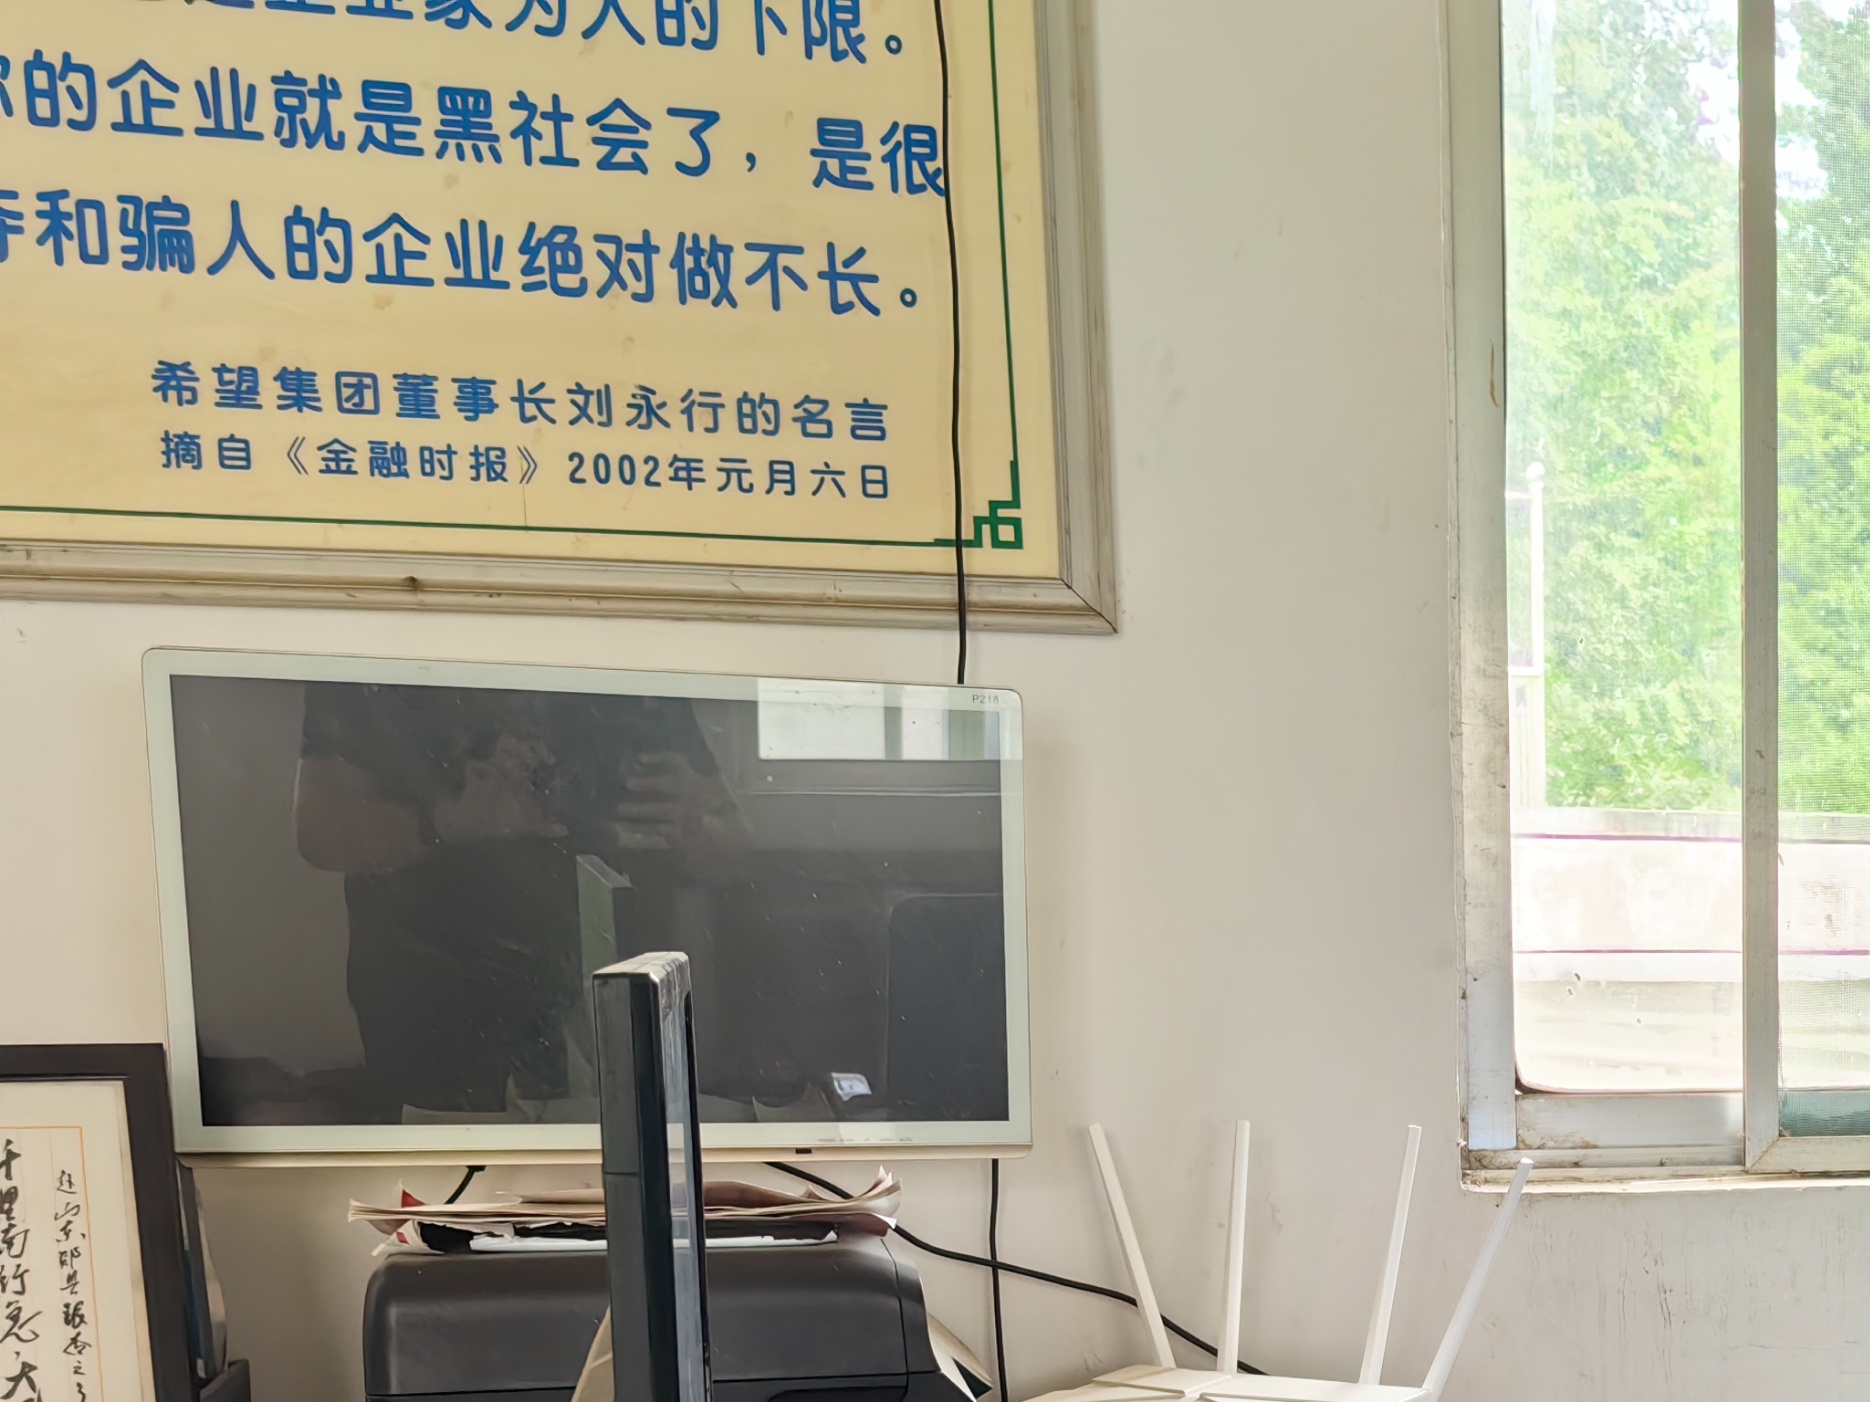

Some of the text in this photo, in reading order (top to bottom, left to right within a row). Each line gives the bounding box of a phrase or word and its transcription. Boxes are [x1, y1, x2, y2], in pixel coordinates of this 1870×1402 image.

[0, 49, 946, 197] 的企业就是黑社会了，是很
[151, 360, 889, 441] 希望集团董事长刘永行的名言
